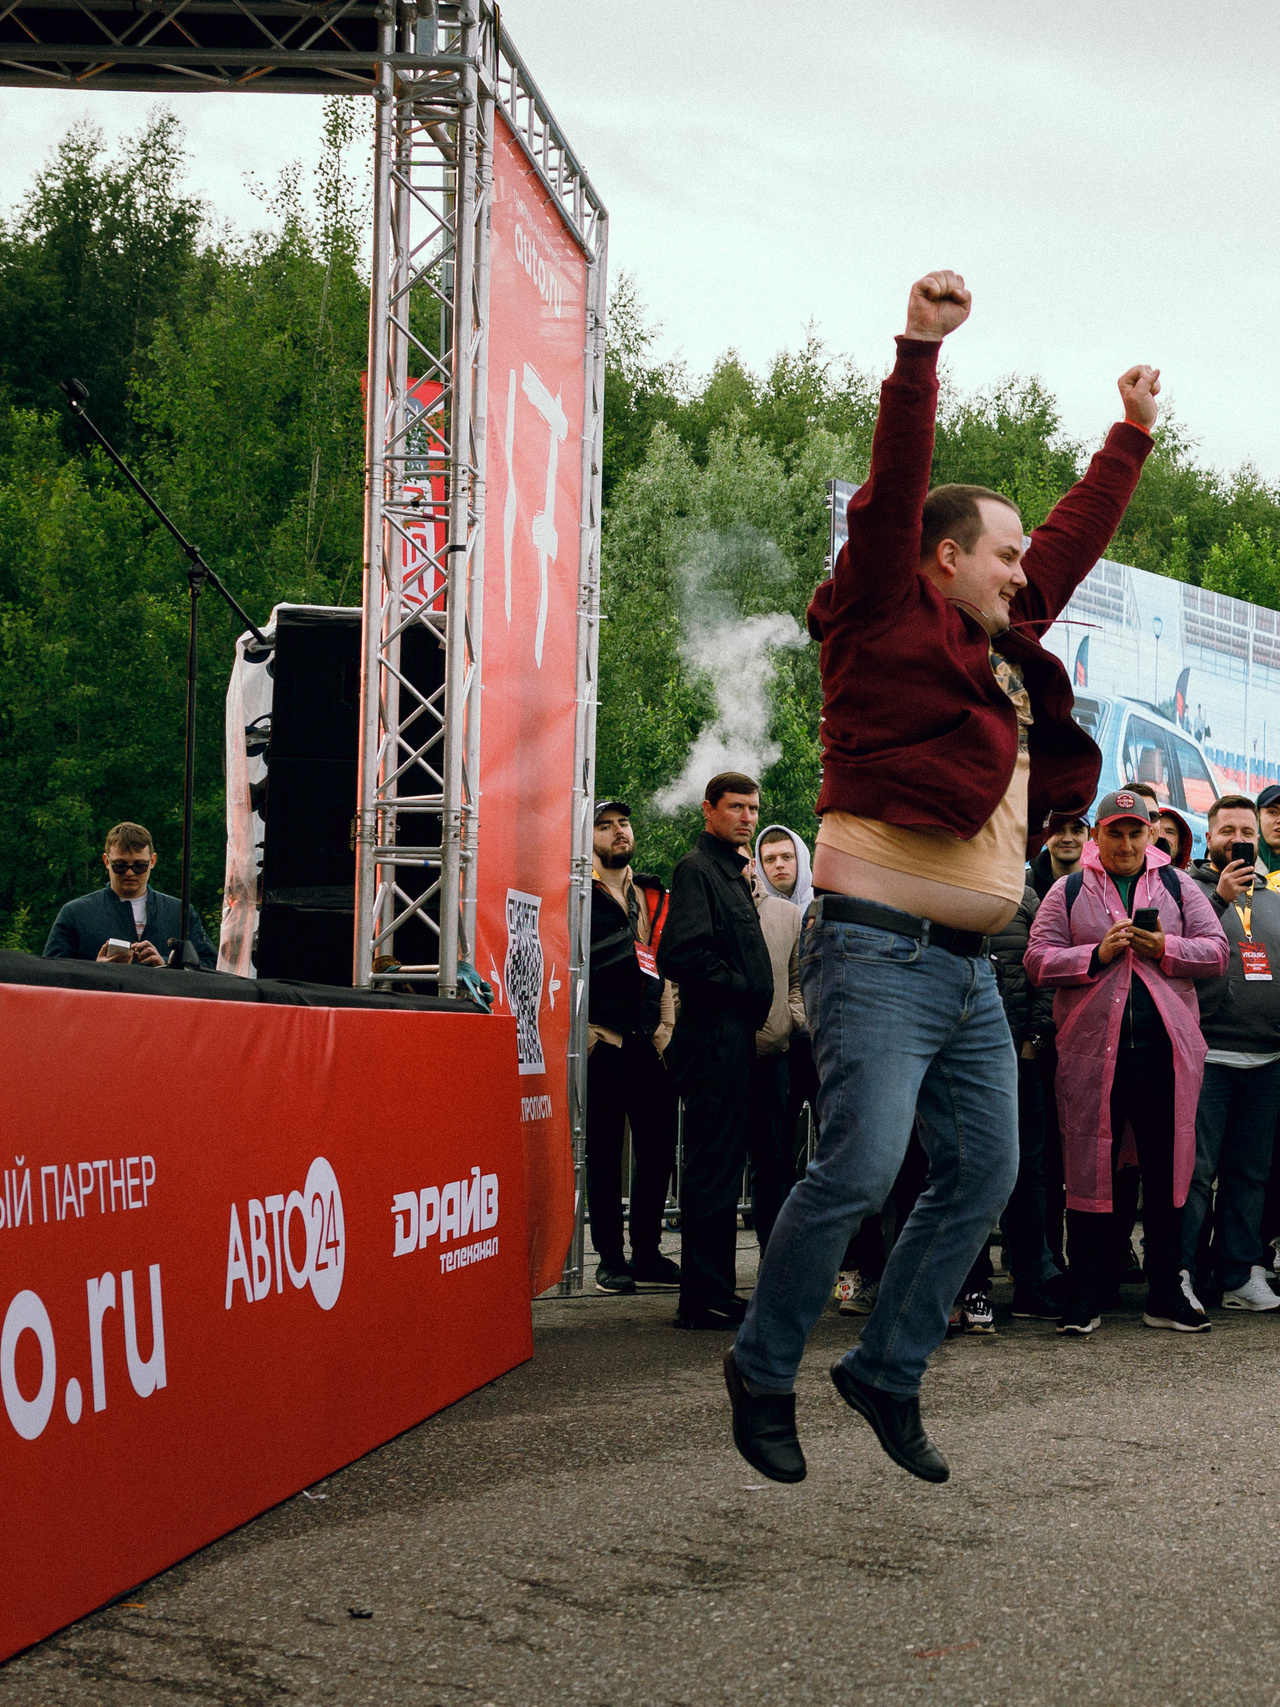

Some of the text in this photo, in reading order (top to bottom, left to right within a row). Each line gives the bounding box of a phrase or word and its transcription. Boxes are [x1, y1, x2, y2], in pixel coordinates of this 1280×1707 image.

[515, 223, 562, 319] auto.ru
[521, 1094, 553, 1122] ПРОПУСТИ
[41, 1155, 156, 1223] ПАРТНЕР
